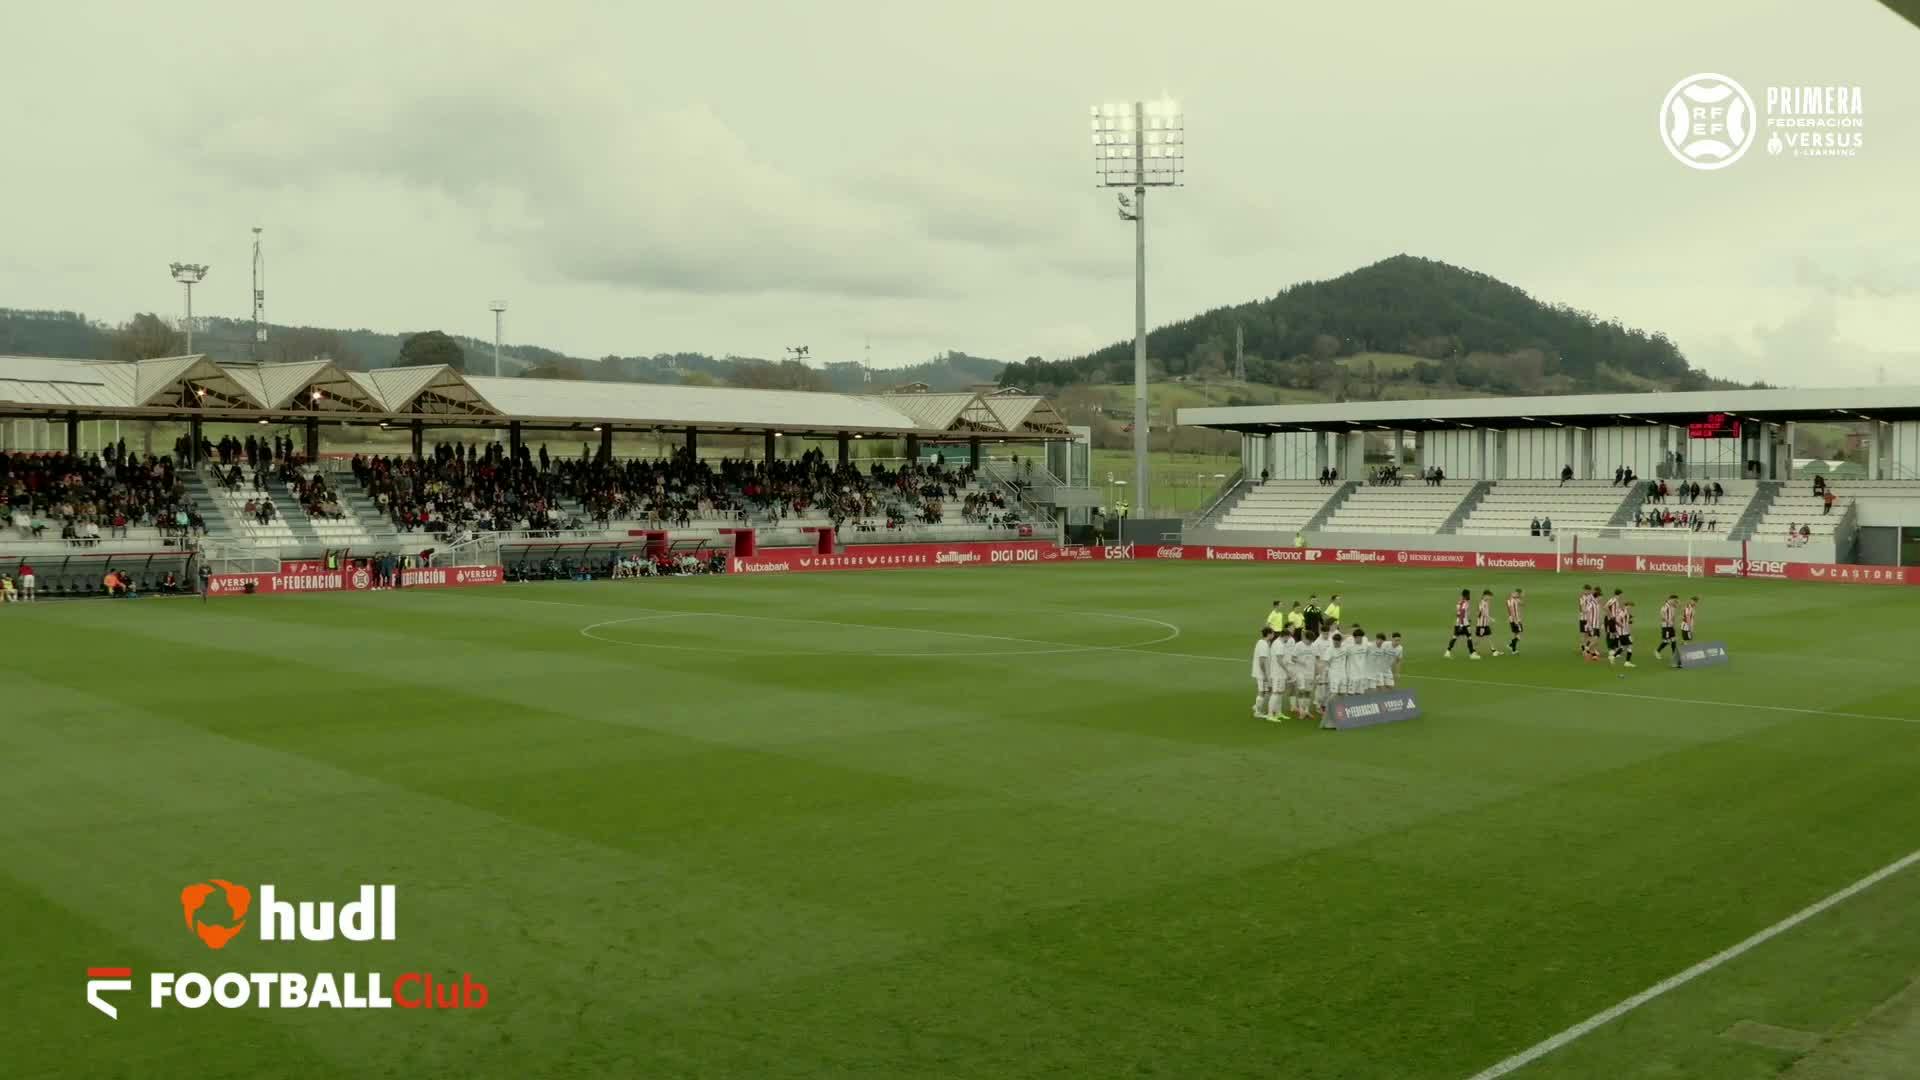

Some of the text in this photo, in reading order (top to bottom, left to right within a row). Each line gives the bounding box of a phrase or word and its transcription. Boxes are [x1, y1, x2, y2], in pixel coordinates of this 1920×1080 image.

[991, 549, 1038, 562] DIGI DIGI
[1105, 545, 1131, 559] GSK
[1215, 551, 1254, 561] kutxabank
[1266, 548, 1303, 561] Petronor
[814, 556, 863, 566] CASTORE
[880, 555, 927, 564] CASTORE
[1487, 557, 1536, 568] kutxabank
[745, 561, 790, 572] kutxabank
[464, 569, 497, 579] VERSUS
[1830, 568, 1905, 581] CASTORE
[284, 572, 342, 590] FEDERACIÓN
